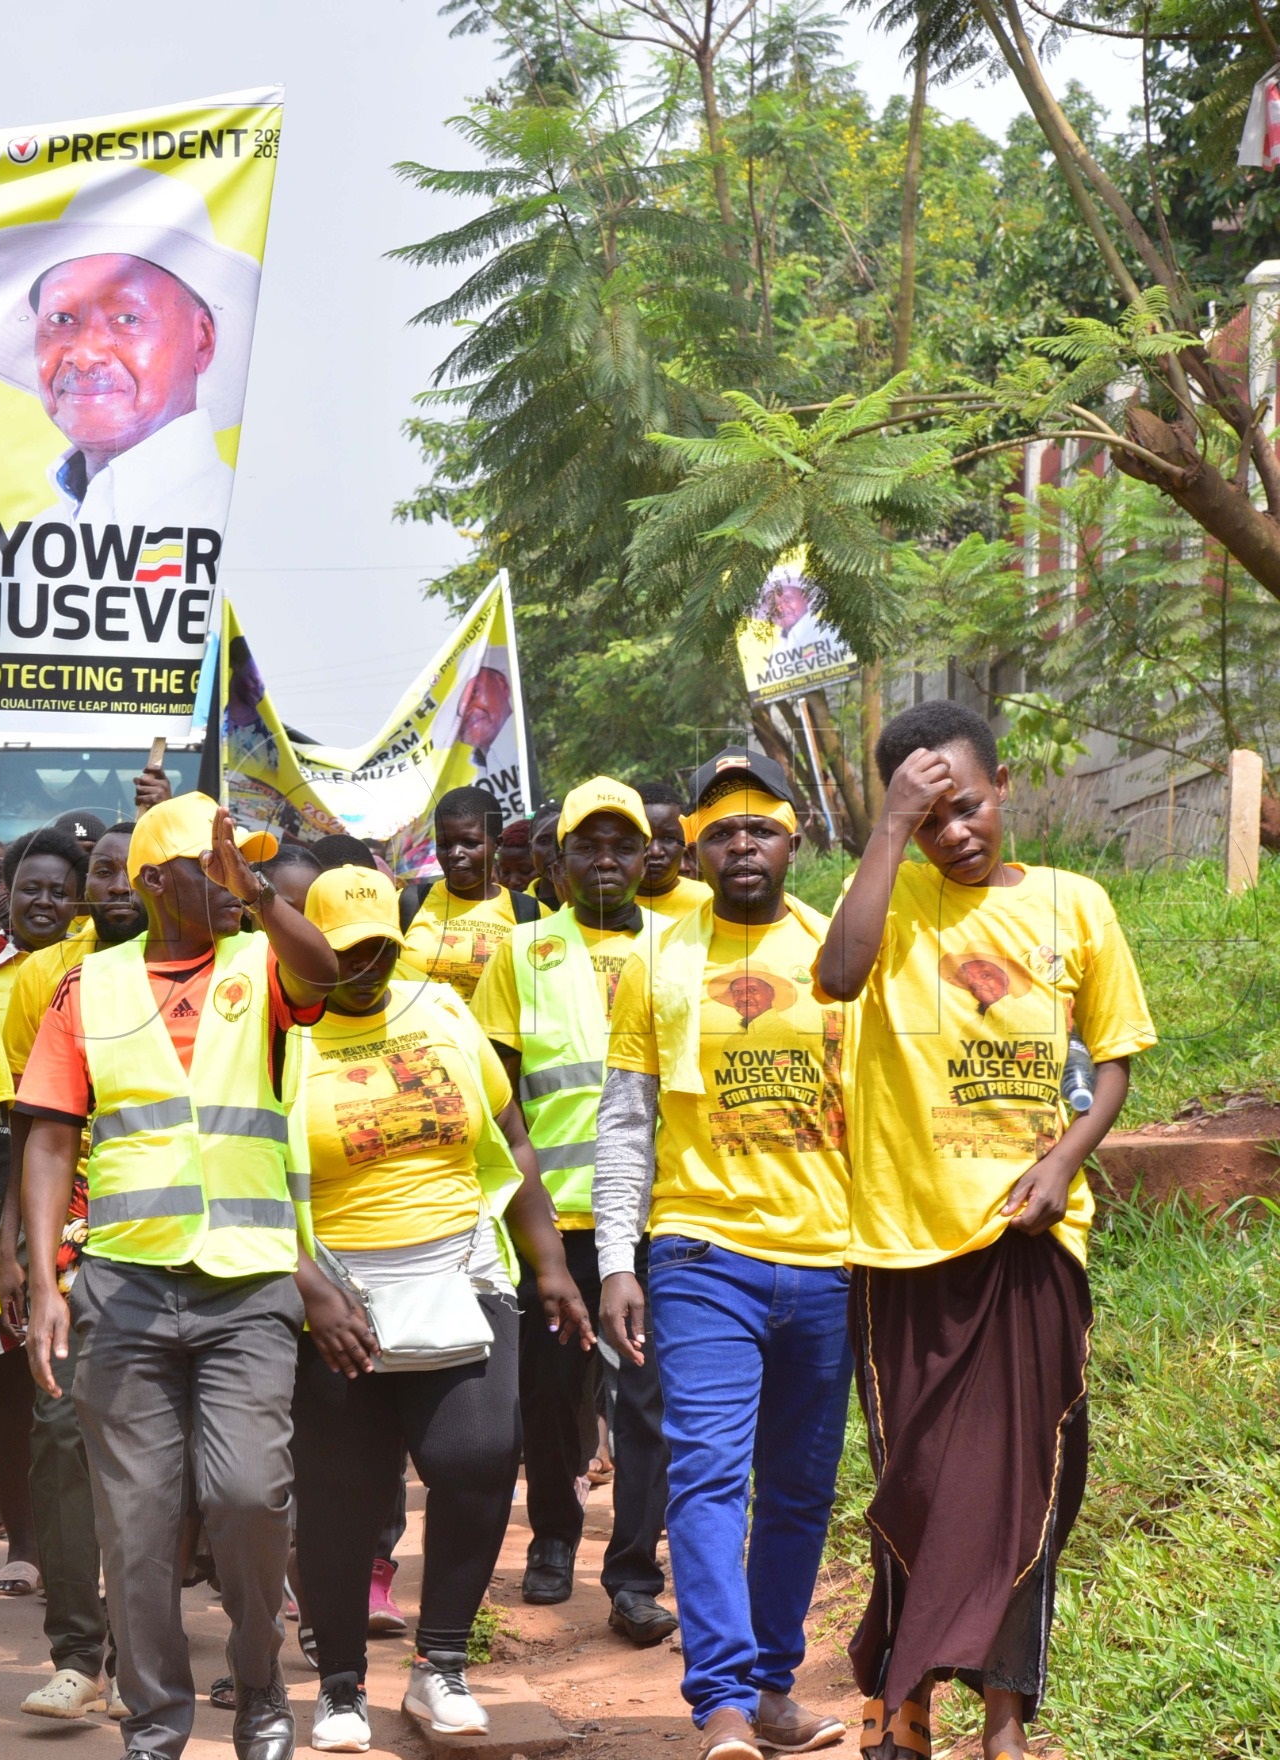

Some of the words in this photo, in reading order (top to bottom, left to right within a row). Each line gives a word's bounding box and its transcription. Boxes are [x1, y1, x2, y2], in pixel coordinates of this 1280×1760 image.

[47, 129, 248, 163] PRESIDENT
[131, 667, 186, 694] THE
[0, 698, 76, 711] QUALITATIVE
[79, 700, 108, 711] LEAP
[110, 701, 138, 712] INTO
[140, 702, 167, 713] HIGH
[74, 822, 87, 836] LA
[345, 887, 378, 901] NRM
[170, 1009, 199, 1019] adidas
[366, 1036, 398, 1054] CREATION
[398, 1030, 429, 1045] PROGRAM
[959, 1039, 1054, 1061] YOWERI
[723, 1049, 810, 1067] YOWERI
[714, 1066, 820, 1086] MUSEVENI
[725, 1088, 750, 1106] FOR
[751, 1084, 814, 1104] PRESIDENT
[957, 1082, 987, 1103] FOR
[987, 1080, 1058, 1104] PRESIDENT
